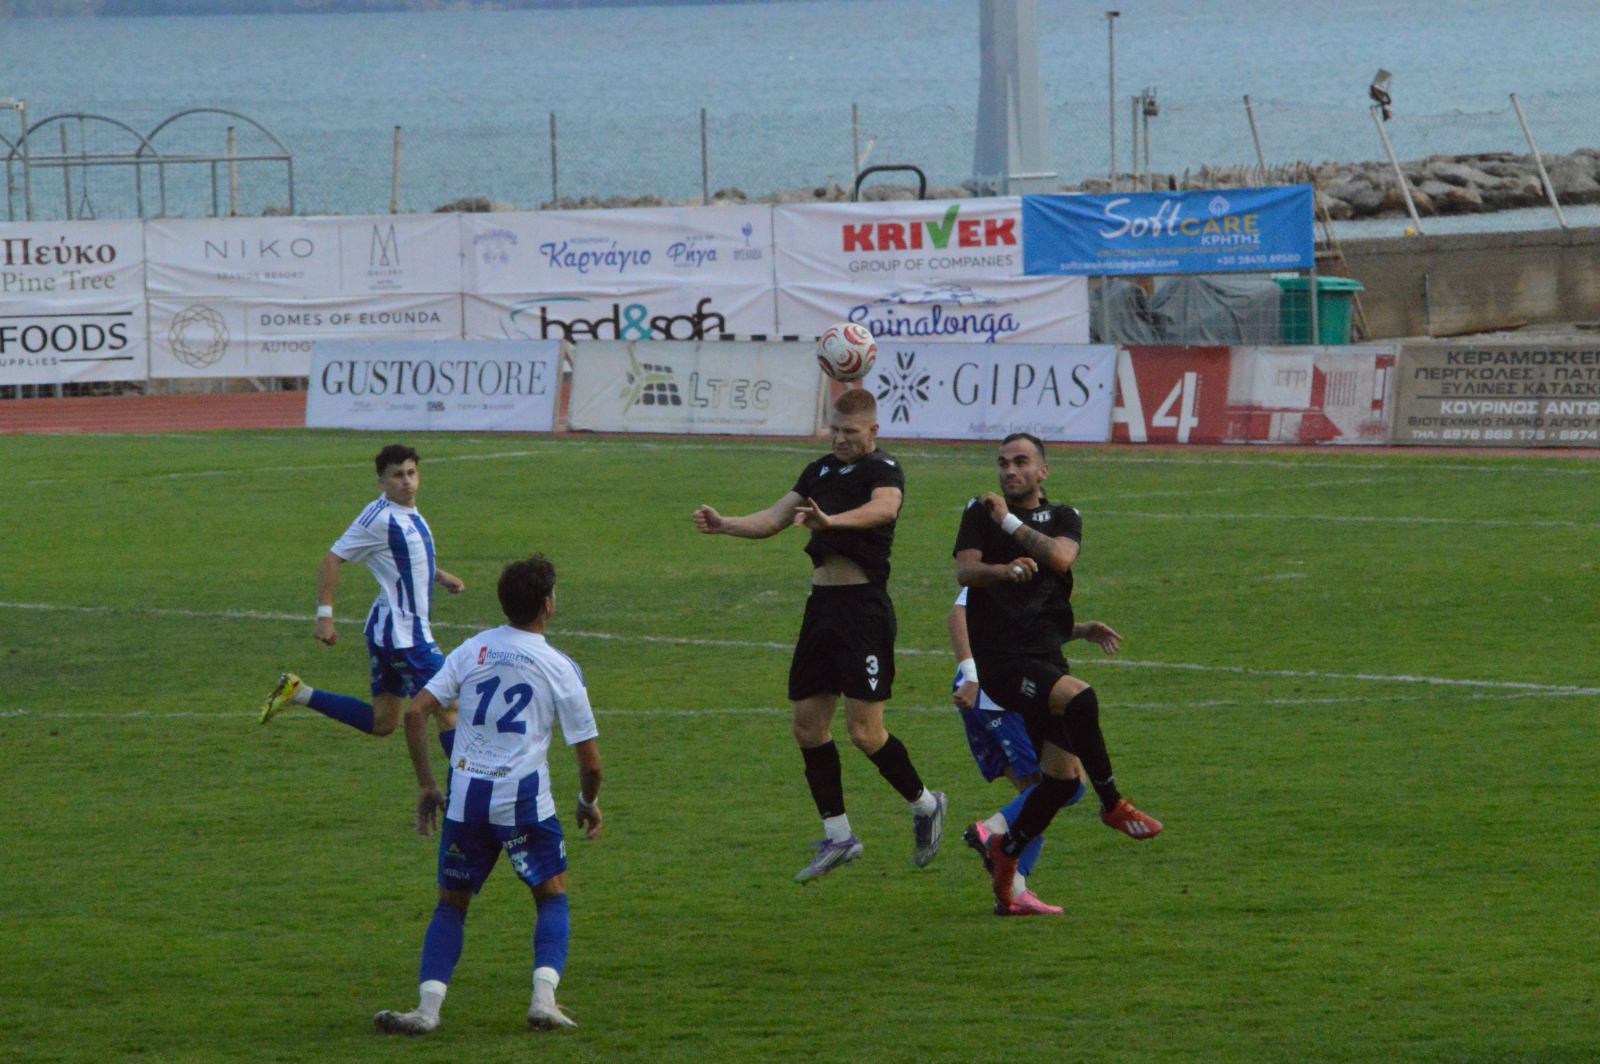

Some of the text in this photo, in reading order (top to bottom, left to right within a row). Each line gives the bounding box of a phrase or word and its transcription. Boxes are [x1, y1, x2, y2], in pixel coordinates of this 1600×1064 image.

[842, 204, 1017, 252] KRIVEK
[204, 238, 314, 259] NIKO
[1201, 233, 1262, 246] ΚΡΗΤΗΣ
[2, 235, 116, 266] Πεύκο
[539, 240, 651, 274] Καρνάγιο
[848, 254, 1013, 274] GROUP OF COMPANIES
[1, 269, 115, 293] Pine Tree
[260, 311, 441, 327] DOMES OF ELOUNDA
[0, 323, 128, 353] FOODS
[260, 340, 316, 352] AUTOG
[321, 360, 547, 396] GUSTOSTORE
[1414, 367, 1600, 380] ΠΕΡΓΚΟΛΕΣ ΠΑΤ
[688, 371, 772, 409] LTEC
[953, 362, 1092, 407] GIPAS
[1441, 382, 1600, 395] ΞΥΛΙΝΕΣ ΚΑΤΑΣΚ
[1441, 401, 1538, 415] ΚΟΥΡΙΝΟΣ
[1408, 416, 1492, 427] ΒΙΟΤΕΧΝΙΚΟ
[1497, 417, 1544, 427] ΠΑΡΚΟ
[865, 654, 879, 675] 3
[472, 675, 533, 735] 12
